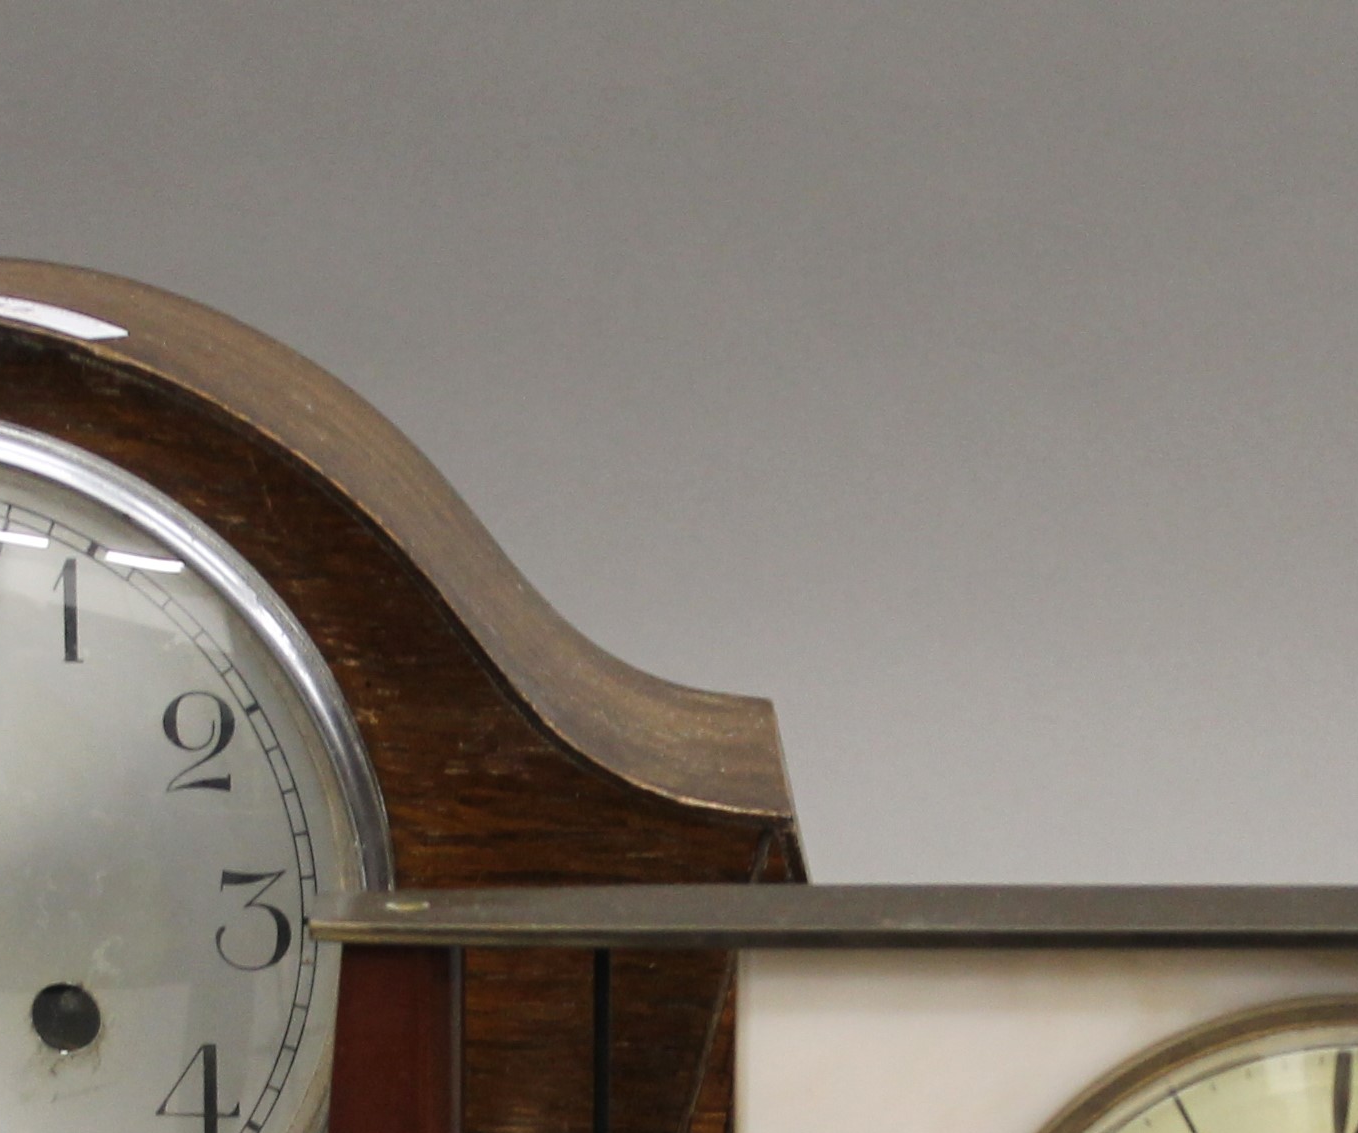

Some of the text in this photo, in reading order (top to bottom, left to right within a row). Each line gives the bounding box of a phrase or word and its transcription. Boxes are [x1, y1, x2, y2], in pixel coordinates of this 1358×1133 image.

[52, 557, 84, 663] 1
[161, 691, 237, 793] 2
[214, 869, 293, 971] 3
